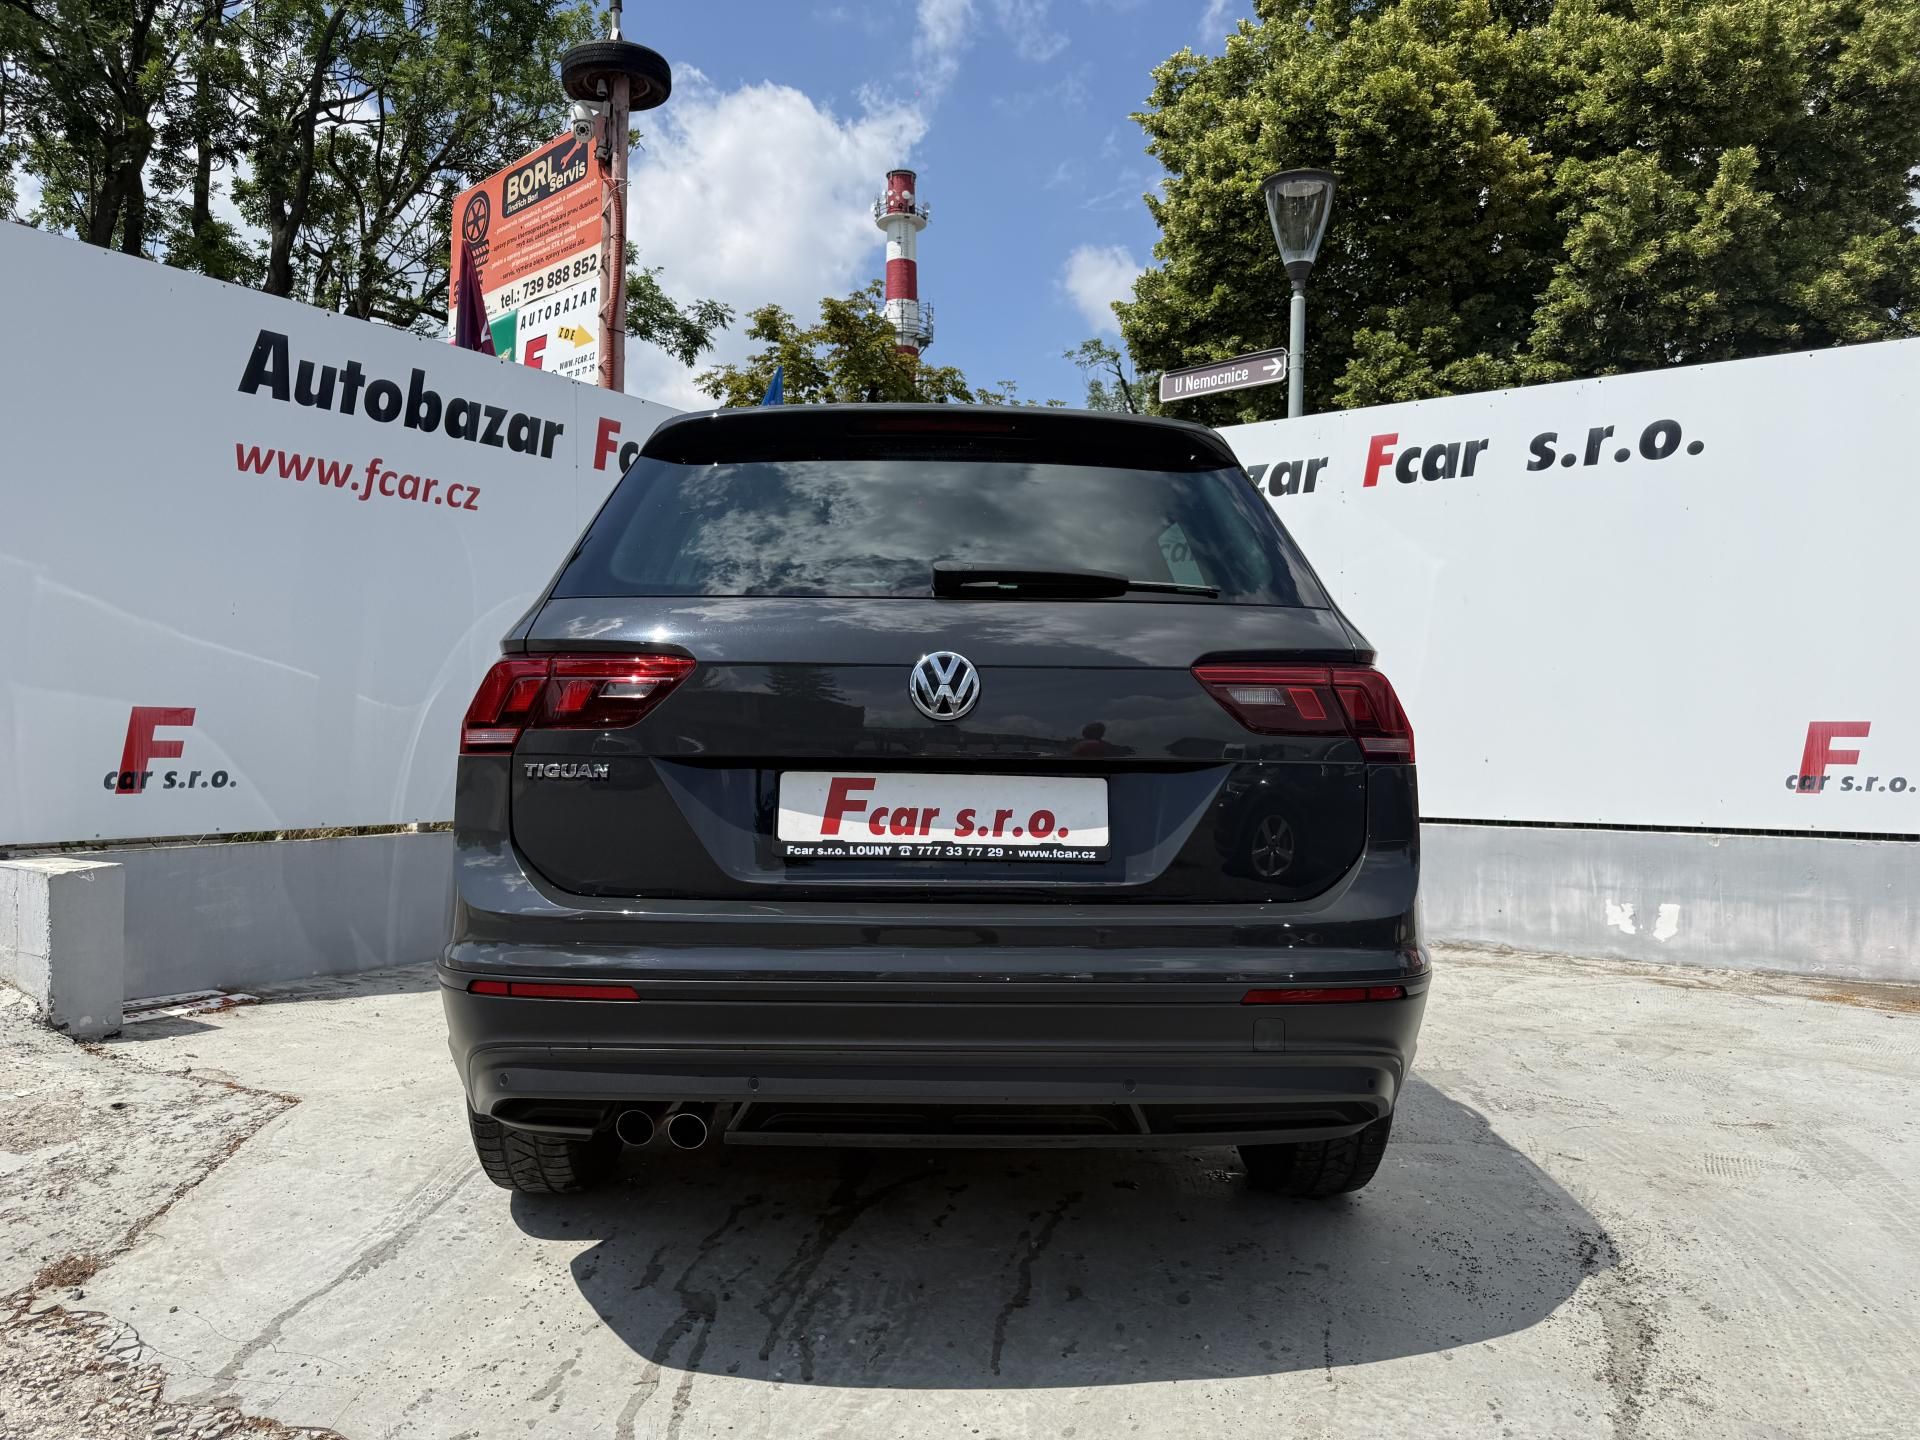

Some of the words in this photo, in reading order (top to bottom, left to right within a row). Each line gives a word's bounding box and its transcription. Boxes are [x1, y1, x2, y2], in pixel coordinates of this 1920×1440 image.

[507, 156, 557, 202] BORL
[550, 159, 586, 192] servis
[501, 288, 520, 309] tel.:
[522, 276, 544, 299] 739
[547, 265, 570, 289] 888
[573, 253, 597, 278] 852
[520, 287, 597, 330] AUTOBAZAR
[559, 327, 576, 341] ZDE
[1175, 377, 1182, 393] U
[1185, 367, 1249, 392] Nemocnice
[238, 329, 564, 458] Autobazar
[593, 416, 640, 474] Fc
[1362, 432, 1489, 488] Fcar
[1526, 418, 1705, 472] s.r.o.
[234, 443, 482, 511] www.fcar.cz
[163, 770, 237, 789] s.r.o.
[524, 763, 610, 778] TIGUAN
[1840, 776, 1917, 793] s.r.o.
[820, 777, 941, 836] Fcar
[954, 807, 1070, 838] s.r.o.
[786, 845, 814, 855] Fcar
[817, 846, 846, 855] s.r.o.
[849, 846, 893, 855] LOUNY
[917, 846, 940, 855] 777
[945, 846, 962, 856] 33
[967, 847, 983, 856] 77
[987, 848, 1003, 857] 29
[1018, 849, 1096, 859] www.fcar.cz
